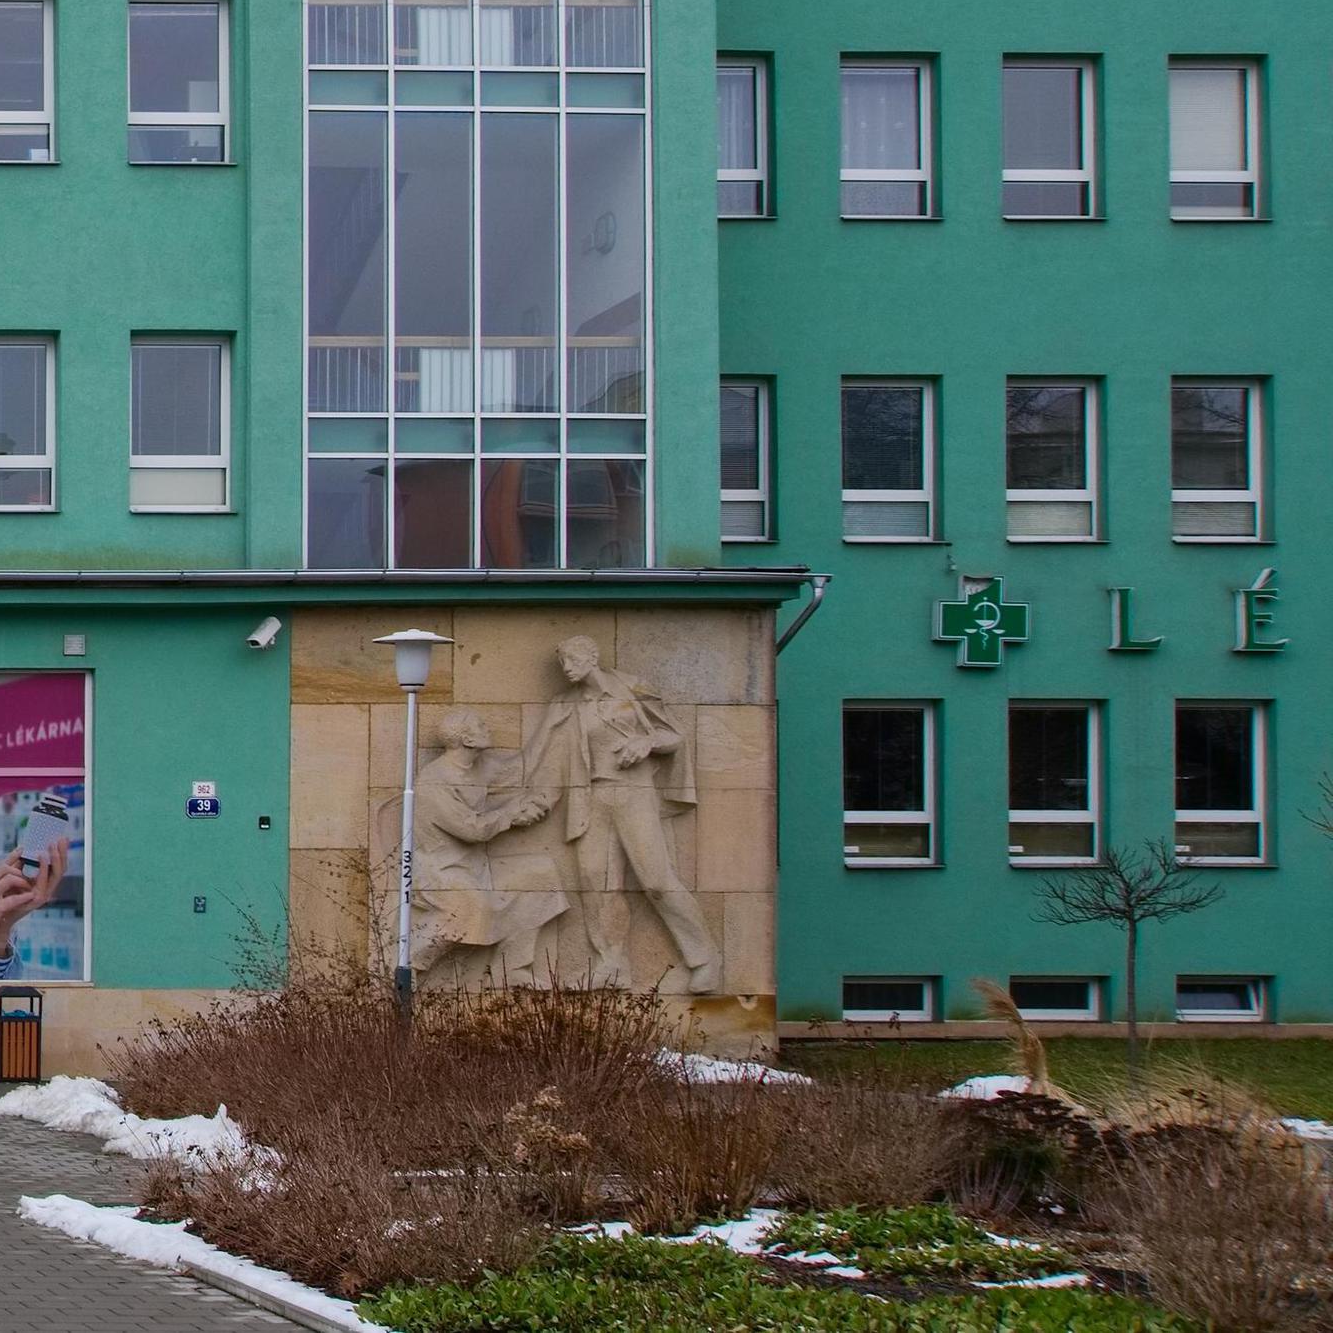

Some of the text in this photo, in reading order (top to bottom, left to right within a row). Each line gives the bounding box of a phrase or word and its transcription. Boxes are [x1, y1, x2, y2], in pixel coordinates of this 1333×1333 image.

[6, 716, 84, 748] LÉKÁRNA
[197, 785, 211, 794] 962
[197, 799, 211, 811] 39
